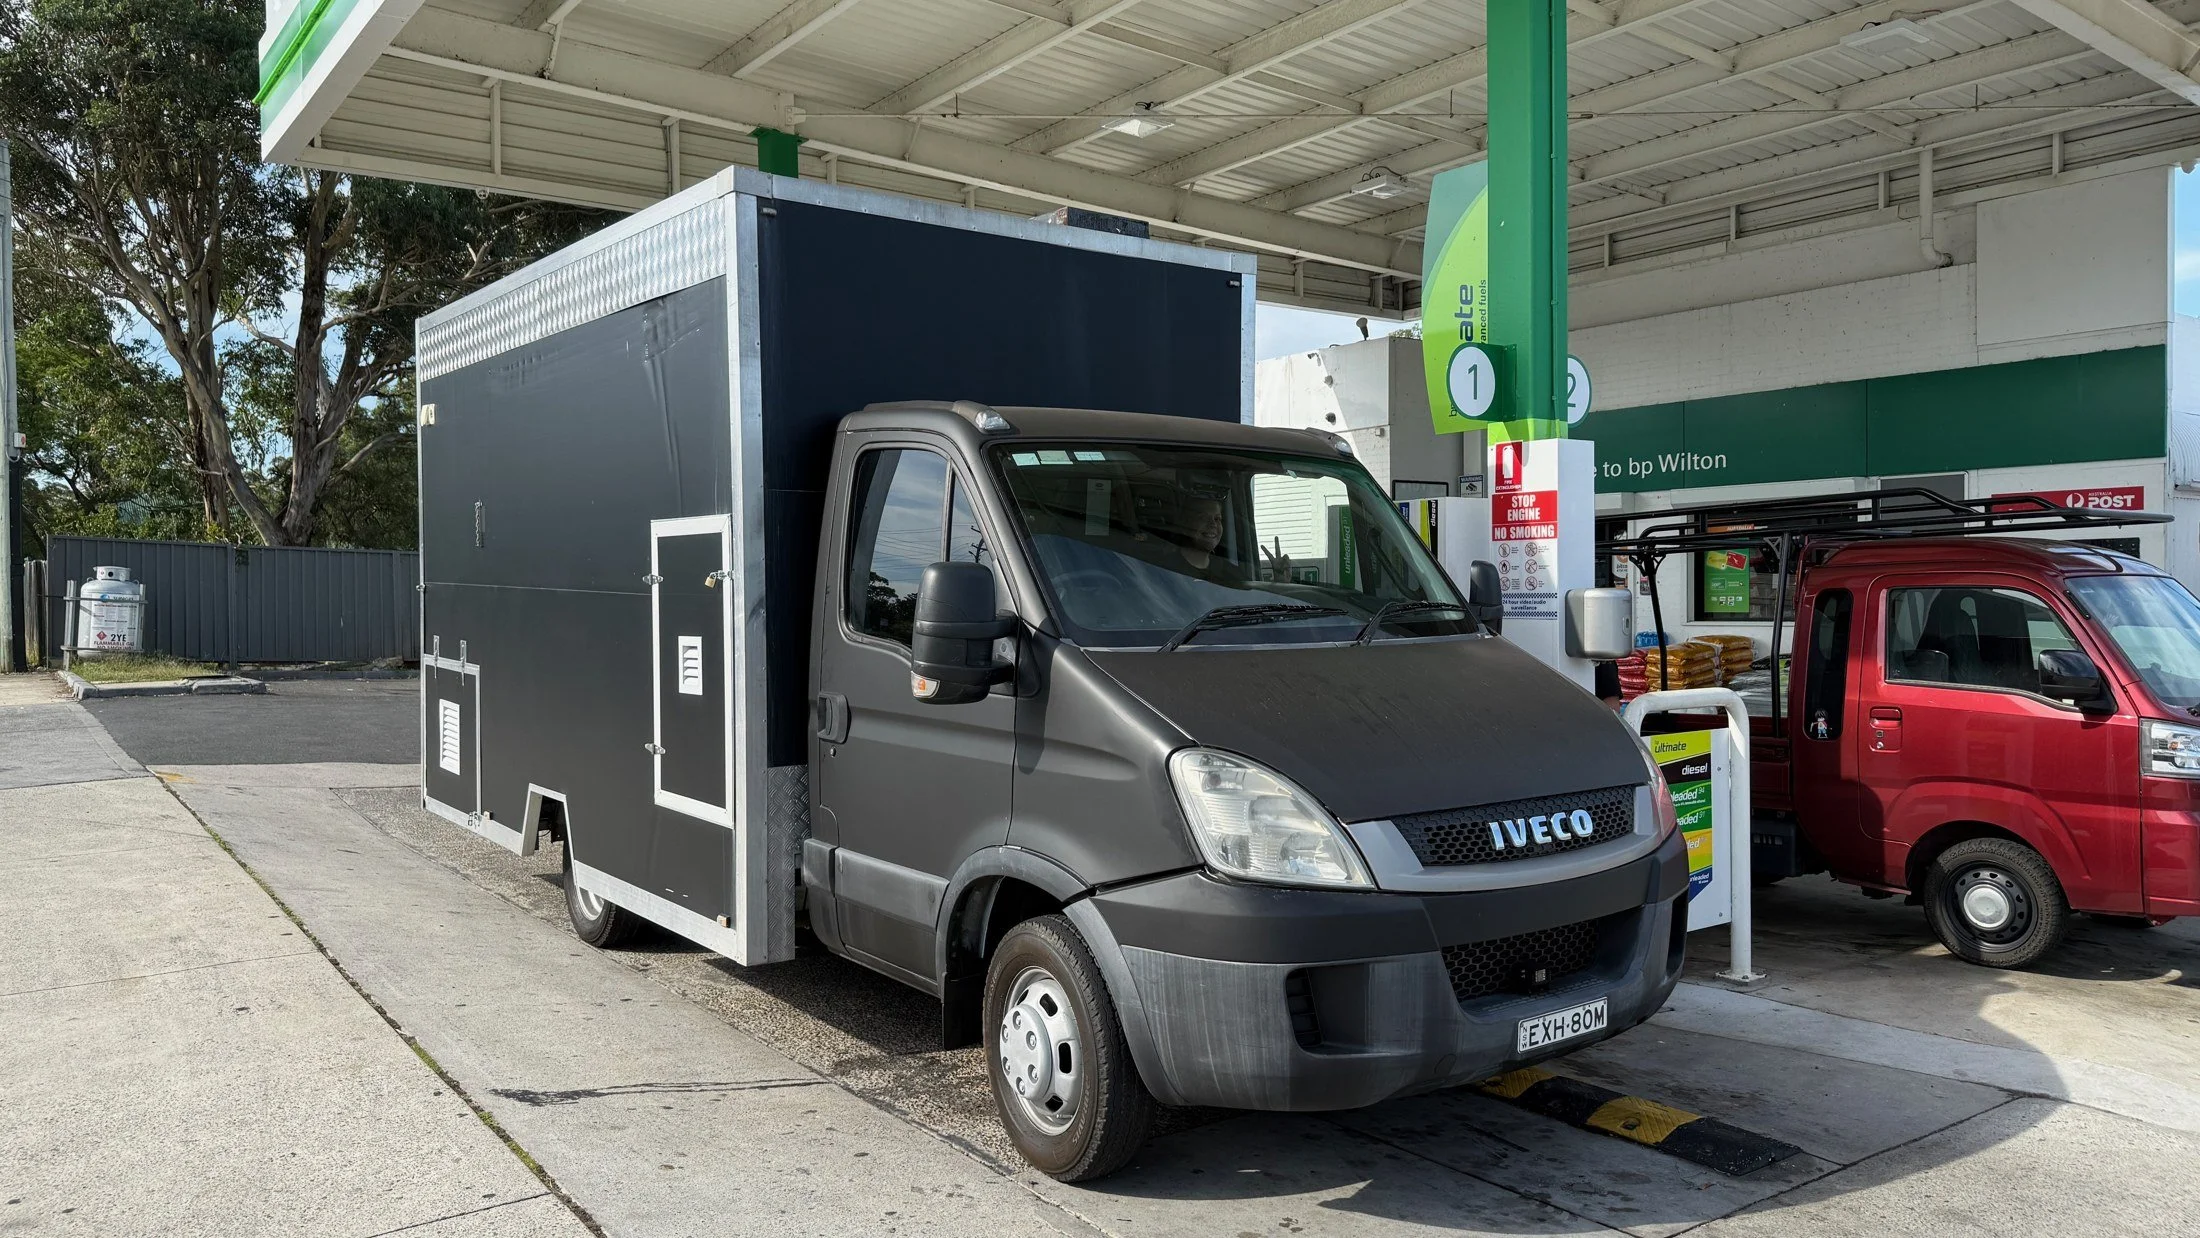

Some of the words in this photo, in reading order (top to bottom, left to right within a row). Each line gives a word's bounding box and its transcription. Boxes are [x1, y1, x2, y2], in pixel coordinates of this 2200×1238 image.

[1479, 279, 1487, 306] fuels
[1467, 363, 1478, 400] 1
[1567, 372, 1577, 408] 2
[1603, 461, 1622, 478] to
[1629, 457, 1653, 479] bp
[1658, 452, 1727, 473] Wilton
[1511, 495, 1536, 508] STOP
[2088, 495, 2135, 508] POST
[1507, 508, 1540, 521] ENGINE
[1494, 527, 1507, 539] NO
[1510, 525, 1554, 539] SMOKING
[110, 634, 126, 642] 2YE
[1655, 742, 1687, 753] ultimate
[1682, 763, 1707, 776] diesel
[1671, 788, 1697, 802] leaded
[1489, 809, 1593, 851] IVECO
